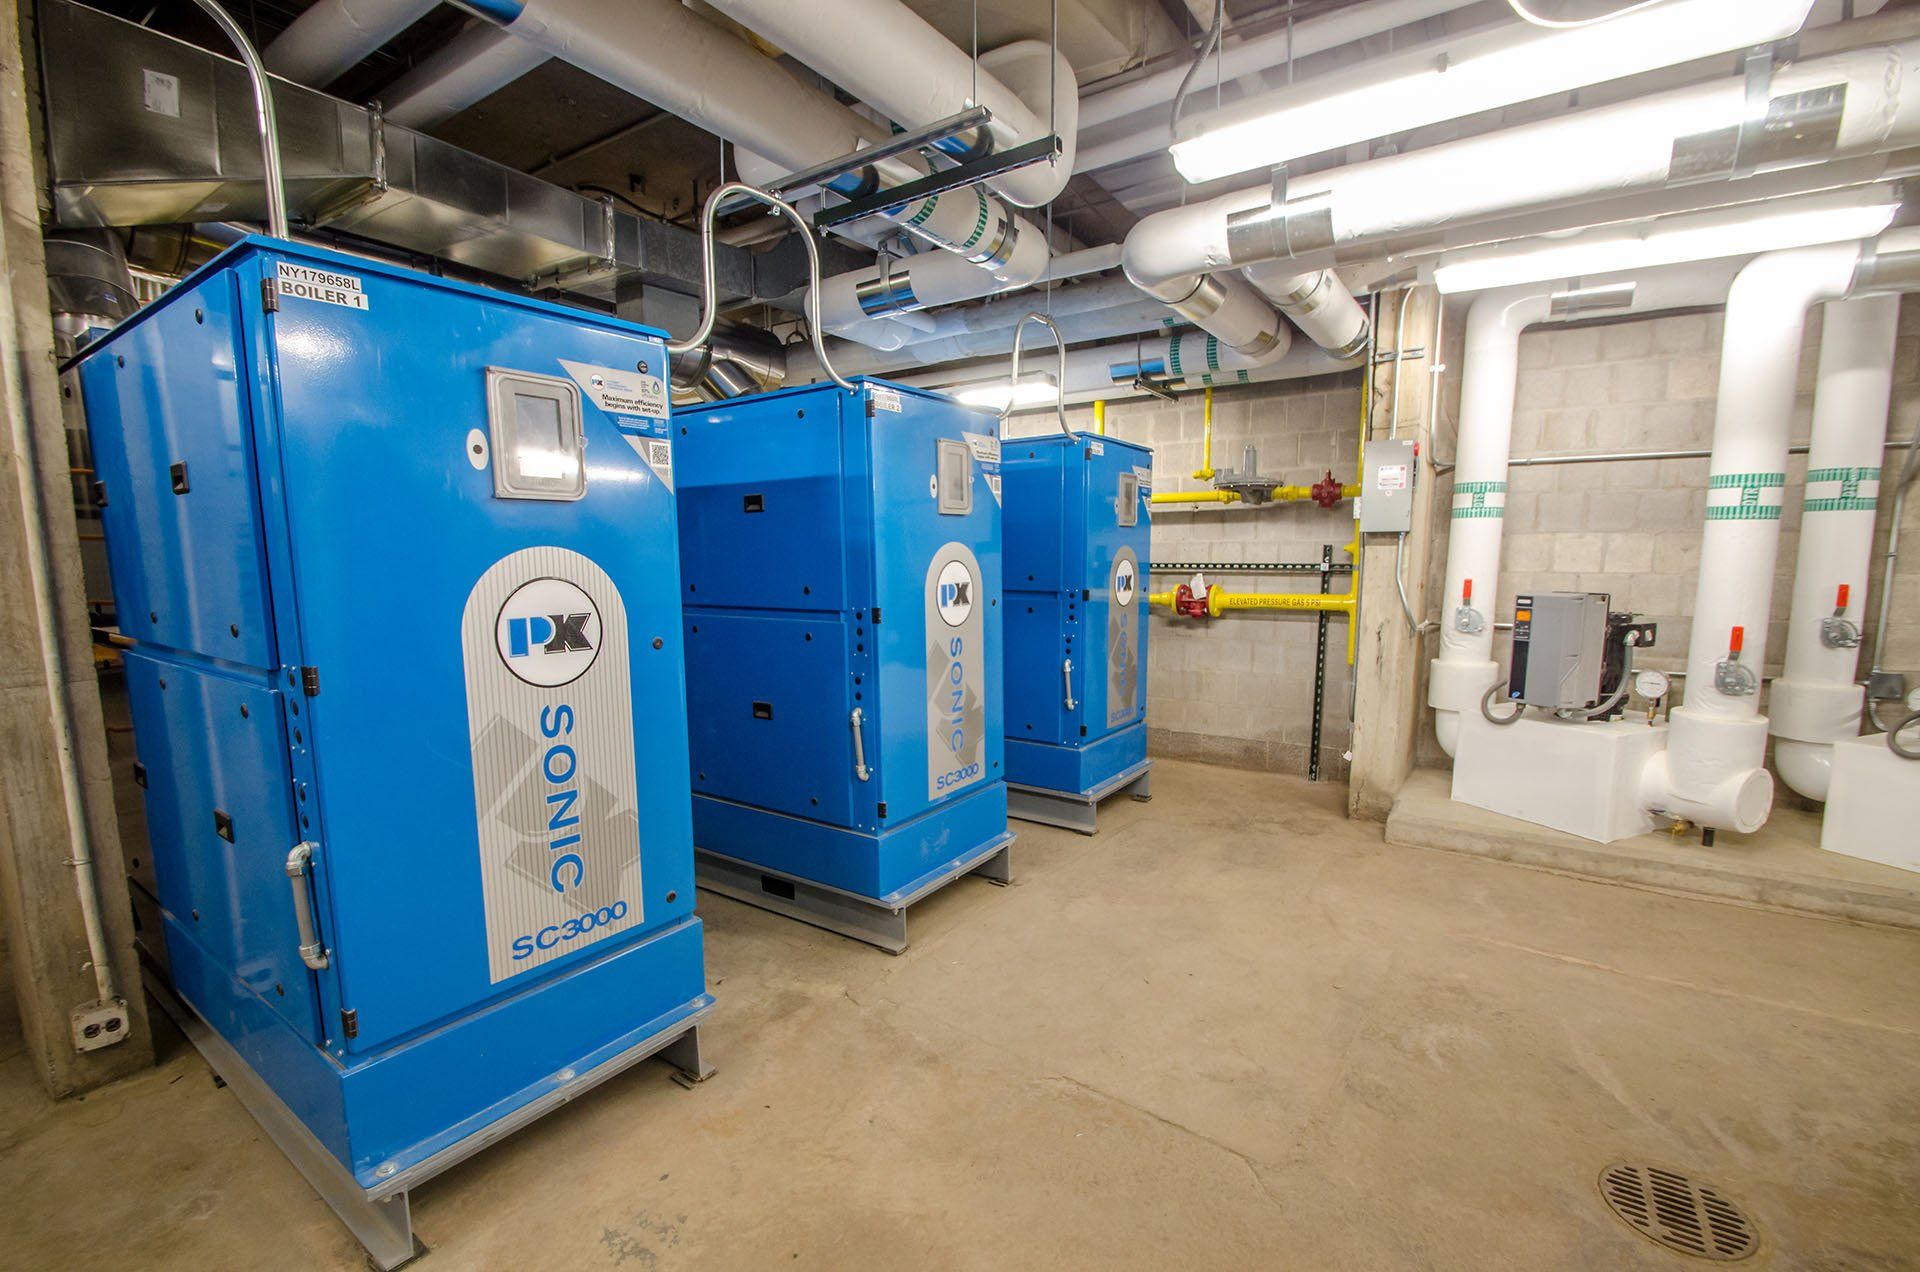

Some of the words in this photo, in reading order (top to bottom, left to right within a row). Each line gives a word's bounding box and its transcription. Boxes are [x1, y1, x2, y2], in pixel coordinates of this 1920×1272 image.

[279, 264, 360, 291] NY179658L
[281, 281, 348, 305] BOILER
[354, 295, 361, 307] 1
[602, 394, 633, 404] Maximum
[634, 399, 663, 410] efficiency
[604, 401, 626, 410] begins
[642, 407, 661, 415] set-up.
[941, 582, 970, 608] PK
[1229, 597, 1257, 606] ELEVATED
[1259, 598, 1290, 606] PRESSURE
[1292, 598, 1304, 607] GAS
[507, 613, 593, 658] PK
[950, 637, 964, 752] SONIC
[936, 762, 979, 790] SC3000
[540, 704, 584, 894] SONIC
[512, 900, 628, 961] SC3000
